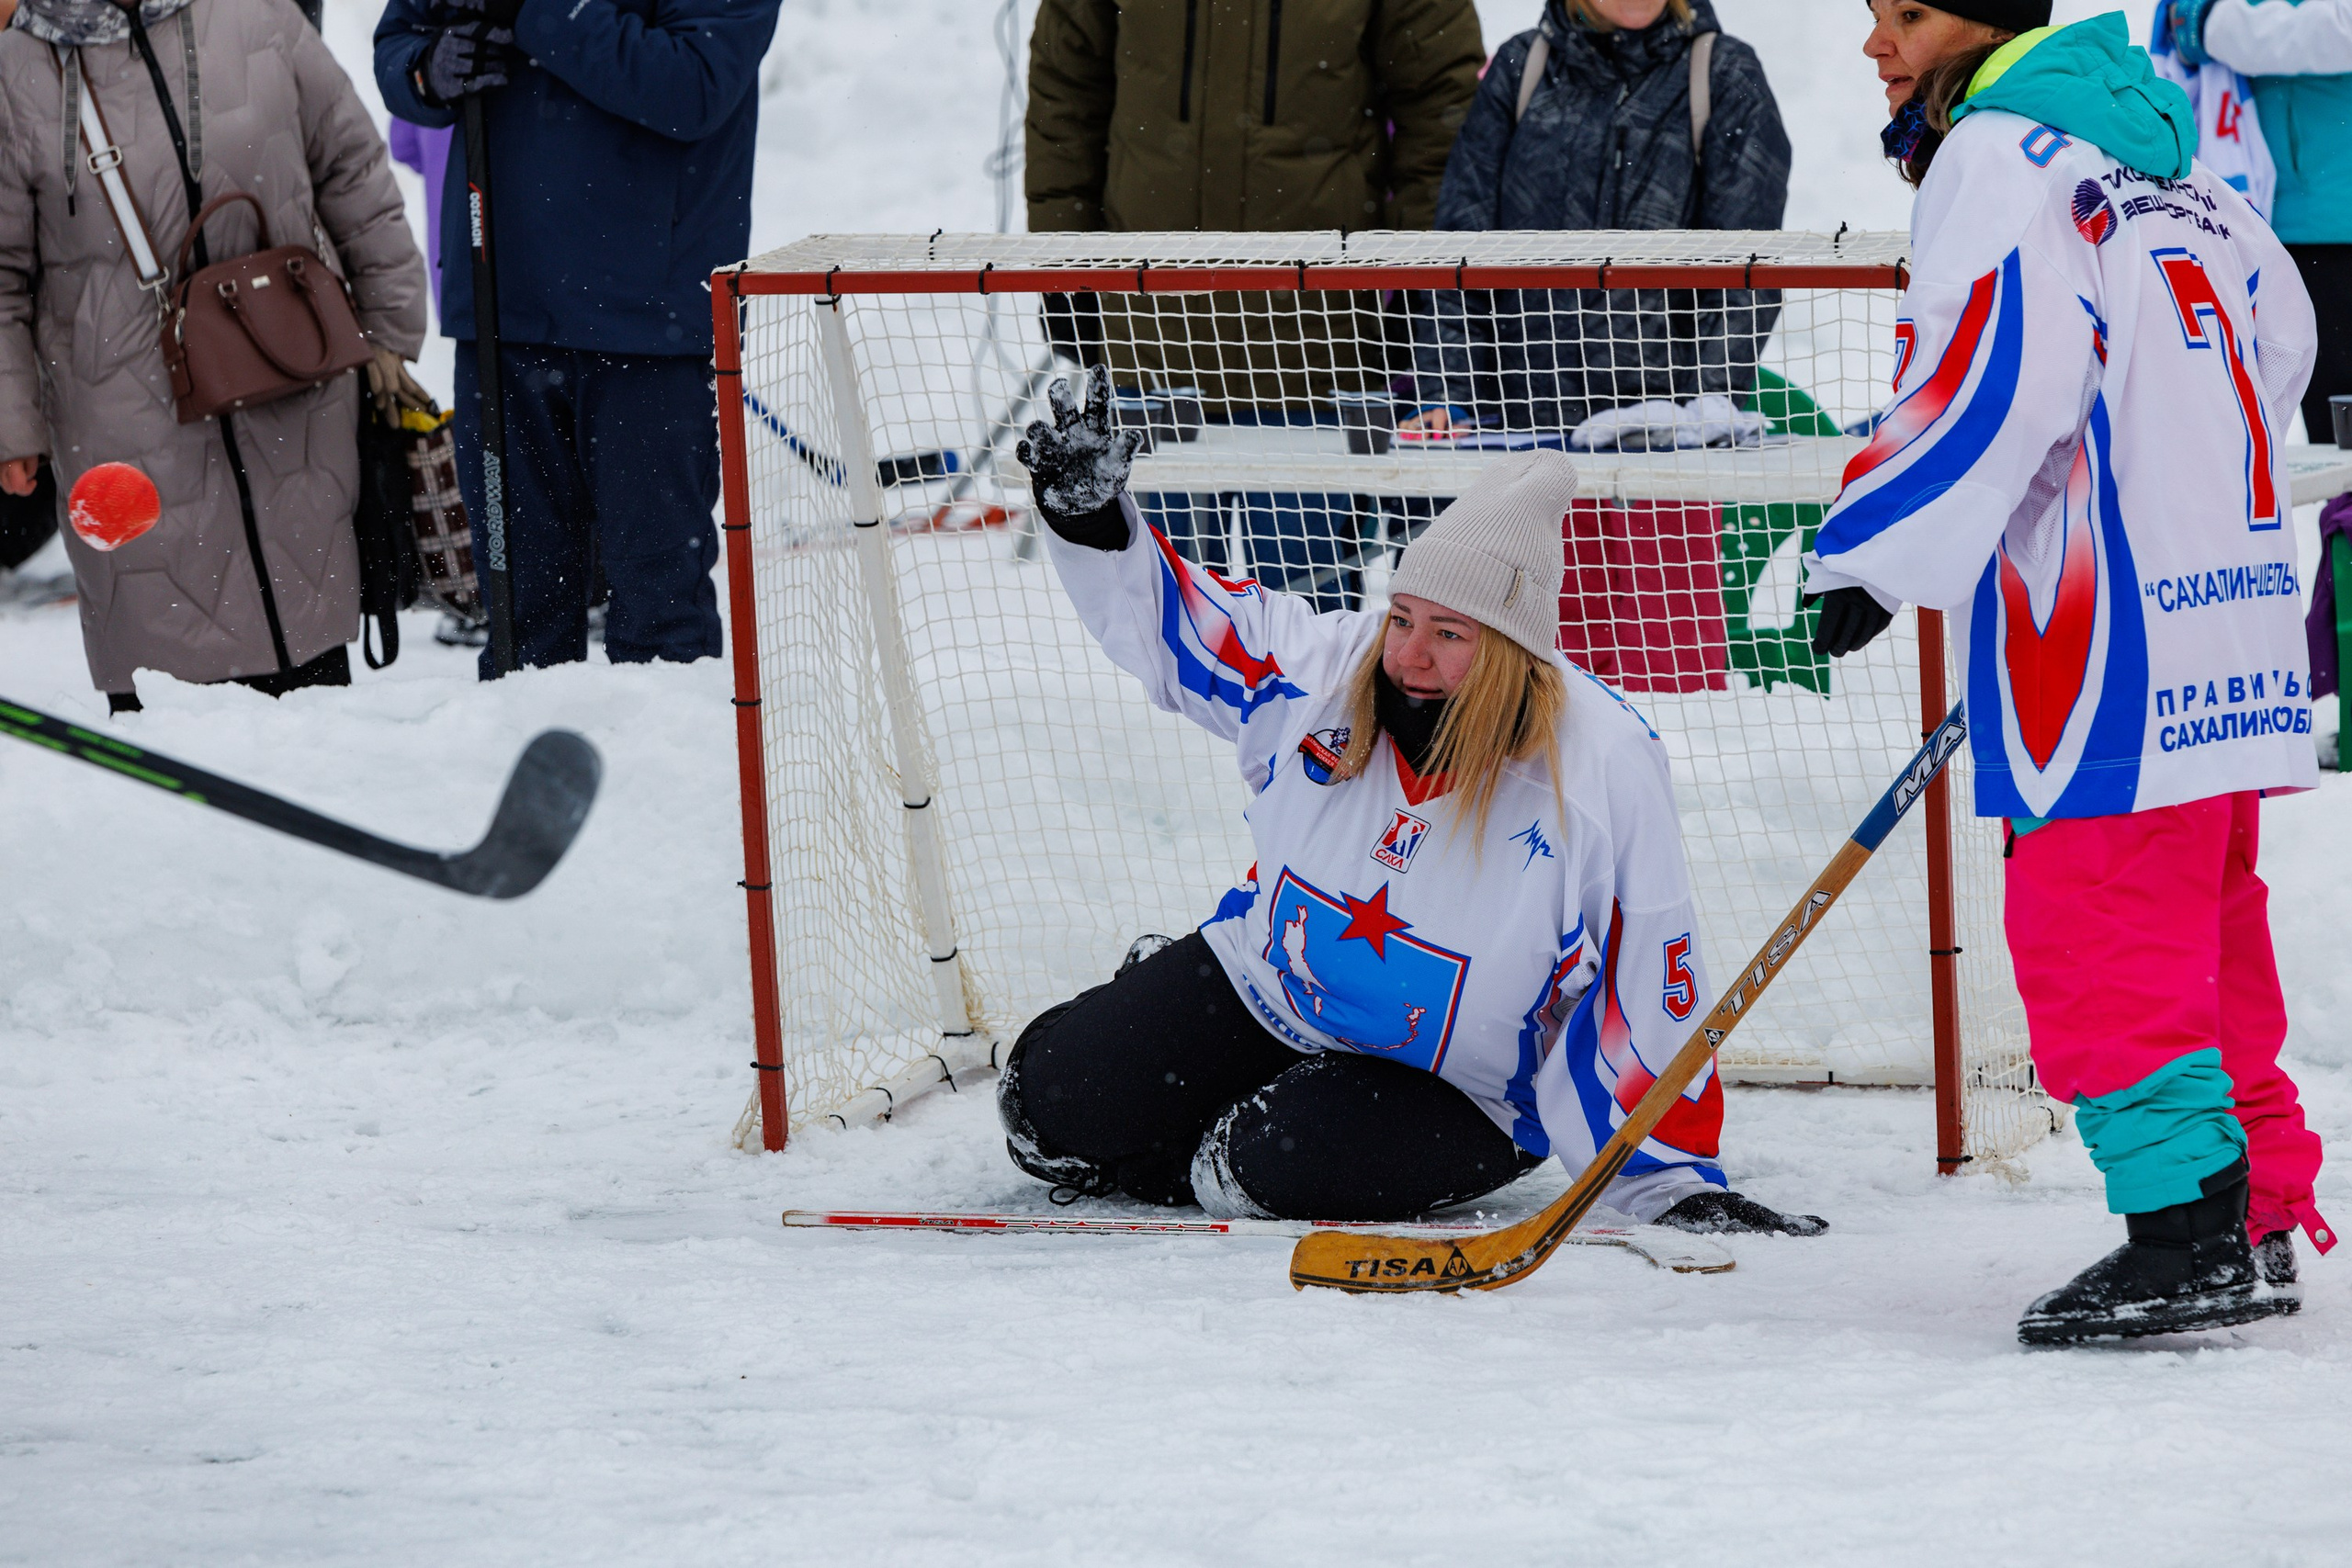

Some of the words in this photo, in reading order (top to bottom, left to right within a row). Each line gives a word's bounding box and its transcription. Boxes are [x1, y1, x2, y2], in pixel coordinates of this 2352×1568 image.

[469, 191, 483, 247] NDW300
[2149, 247, 2282, 532] 7
[483, 449, 506, 571] NORDWAY
[1662, 931, 1700, 1022] 5
[1717, 890, 1832, 1017] TISA
[1344, 1258, 1436, 1279] TISA
